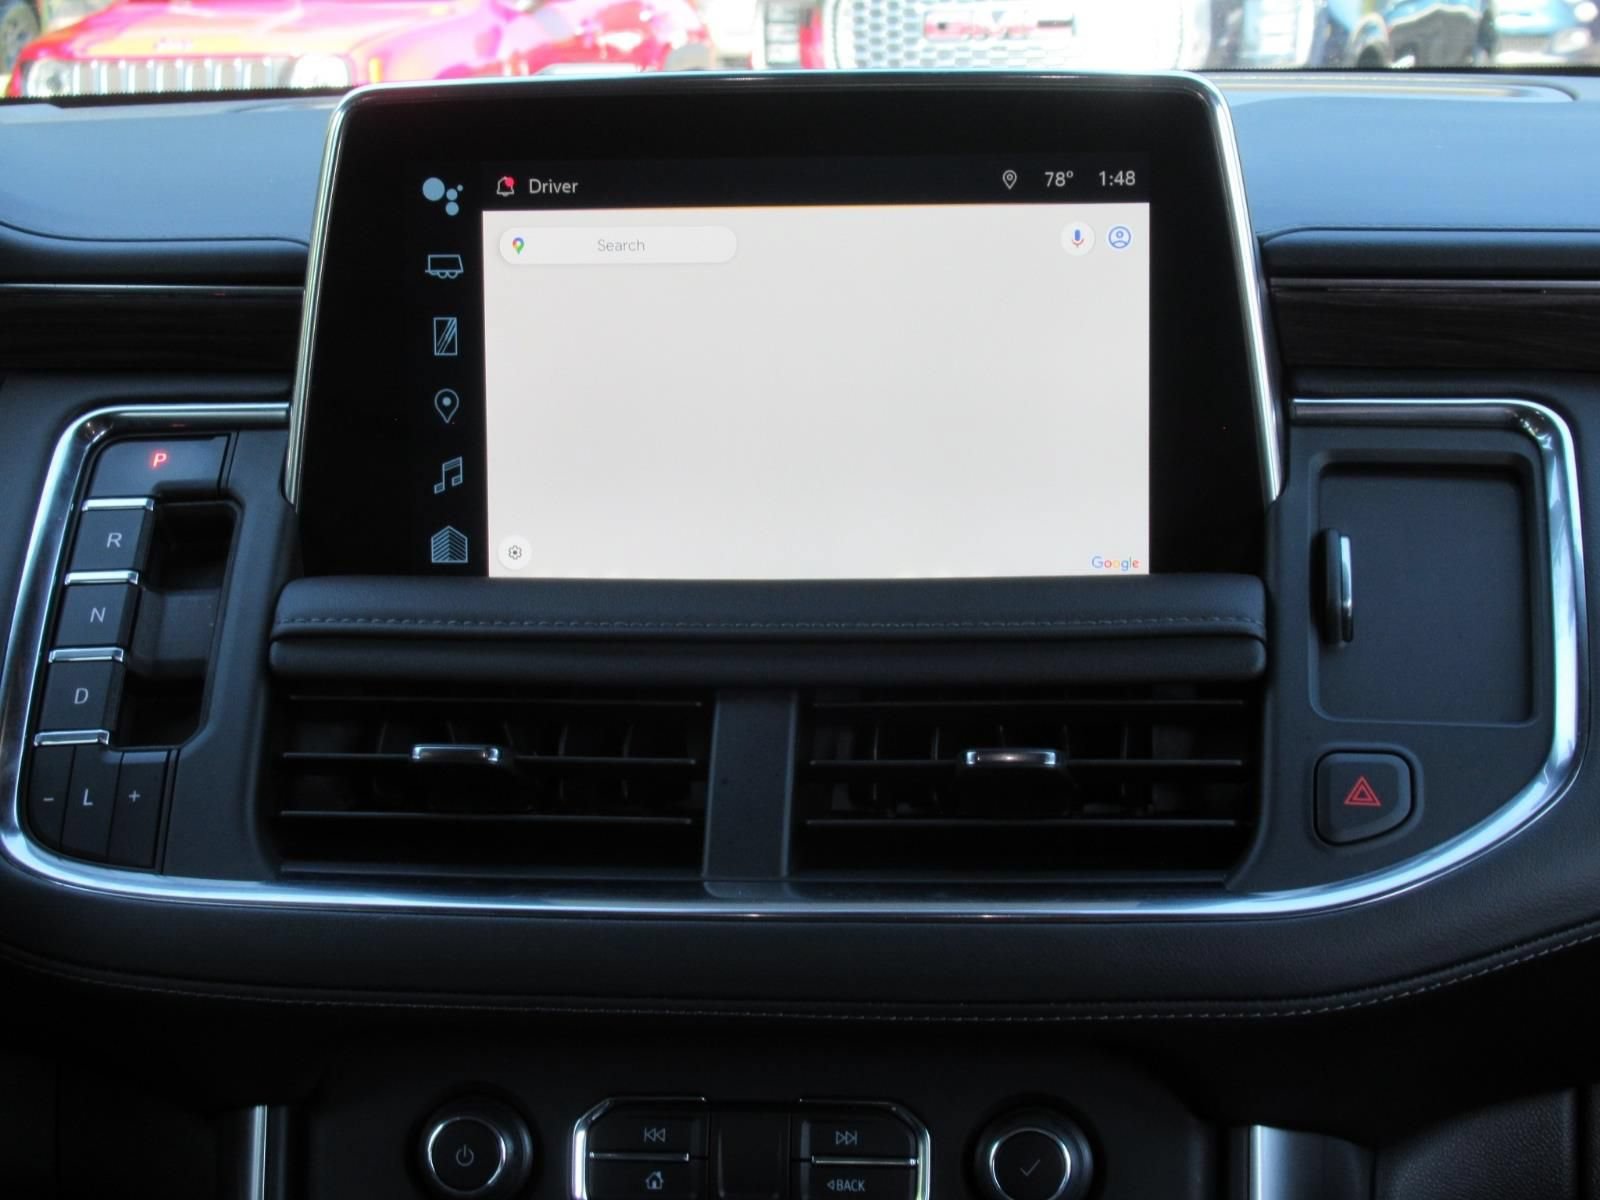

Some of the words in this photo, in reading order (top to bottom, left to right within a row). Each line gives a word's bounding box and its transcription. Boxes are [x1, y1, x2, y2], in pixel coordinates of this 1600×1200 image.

[528, 178, 579, 194] Driver
[1098, 170, 1136, 187] 1:48
[597, 239, 646, 252] Search
[153, 453, 167, 468] P
[106, 532, 123, 548] R
[1091, 555, 1141, 572] Google
[90, 607, 106, 623] N
[74, 687, 89, 704] D
[83, 788, 93, 806] L
[836, 1179, 866, 1192] BACK
